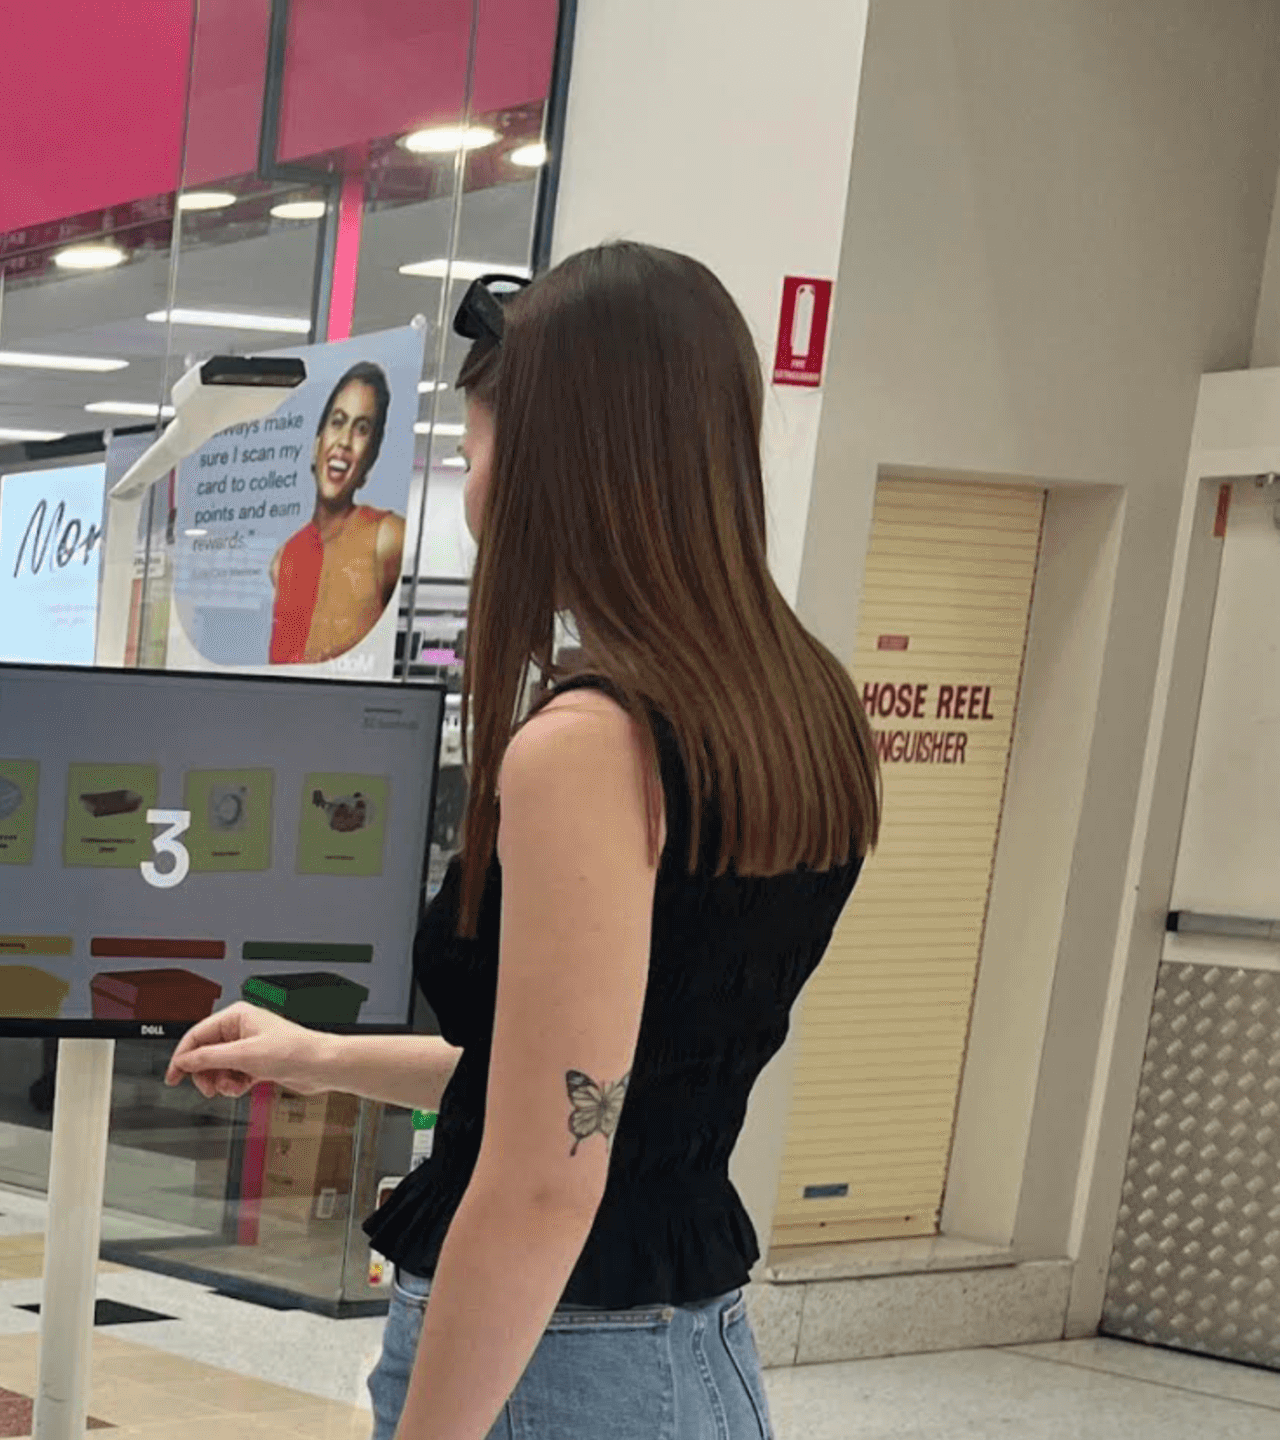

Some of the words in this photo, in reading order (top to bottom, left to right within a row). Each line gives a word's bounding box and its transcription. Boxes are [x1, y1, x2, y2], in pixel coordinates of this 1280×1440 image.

[263, 412, 305, 432] make
[199, 450, 230, 468] sure
[242, 447, 276, 464] scan
[279, 443, 304, 463] my
[197, 474, 228, 495] card
[230, 474, 246, 493] to
[249, 471, 298, 492] collect
[194, 505, 235, 526] points
[238, 500, 267, 521] and
[863, 682, 929, 718] HOSE
[936, 684, 994, 720] REEL
[875, 729, 968, 765] NGUISHER
[140, 808, 192, 889] 3
